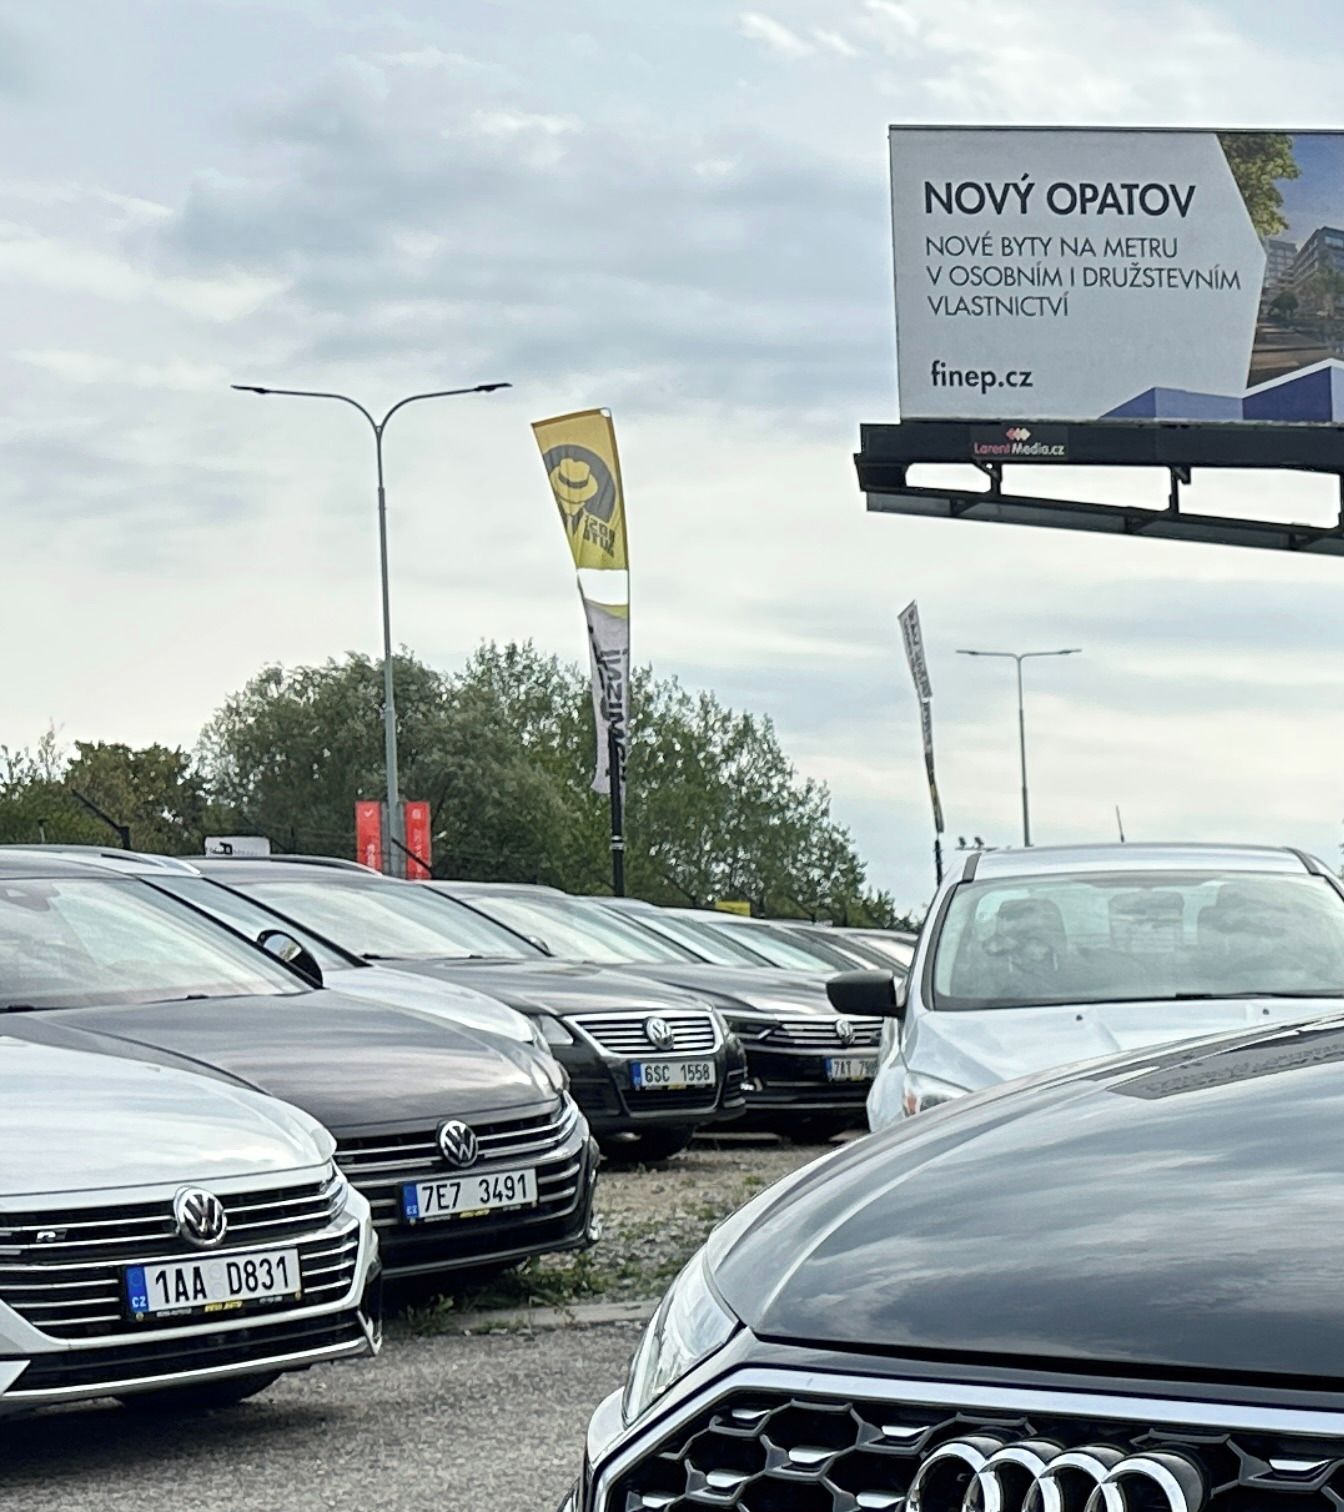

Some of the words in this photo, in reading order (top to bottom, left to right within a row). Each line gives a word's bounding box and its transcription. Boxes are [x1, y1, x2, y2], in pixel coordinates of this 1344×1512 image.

[923, 172, 1036, 215] NOVÝ
[1046, 181, 1197, 219] OPATOV
[925, 230, 994, 257] NOVÉ
[1001, 236, 1052, 258] BYTY
[1060, 236, 1097, 258] NA
[1103, 237, 1178, 259] METRU
[925, 265, 943, 286] V
[948, 261, 1063, 288] OSOBNÍM
[1070, 266, 1075, 287] I
[1082, 262, 1241, 290] DRUŽSTEVNÍM
[926, 291, 1070, 317] VLASTNICTVÍ
[931, 359, 1034, 395] finep.cz
[644, 1064, 671, 1083] 6SC
[680, 1063, 710, 1082] 1558
[421, 1181, 462, 1213] 7E7
[478, 1173, 527, 1205] 3491
[155, 1266, 208, 1305] 1AA
[226, 1255, 289, 1296] D831
[131, 1296, 147, 1308] CZ
